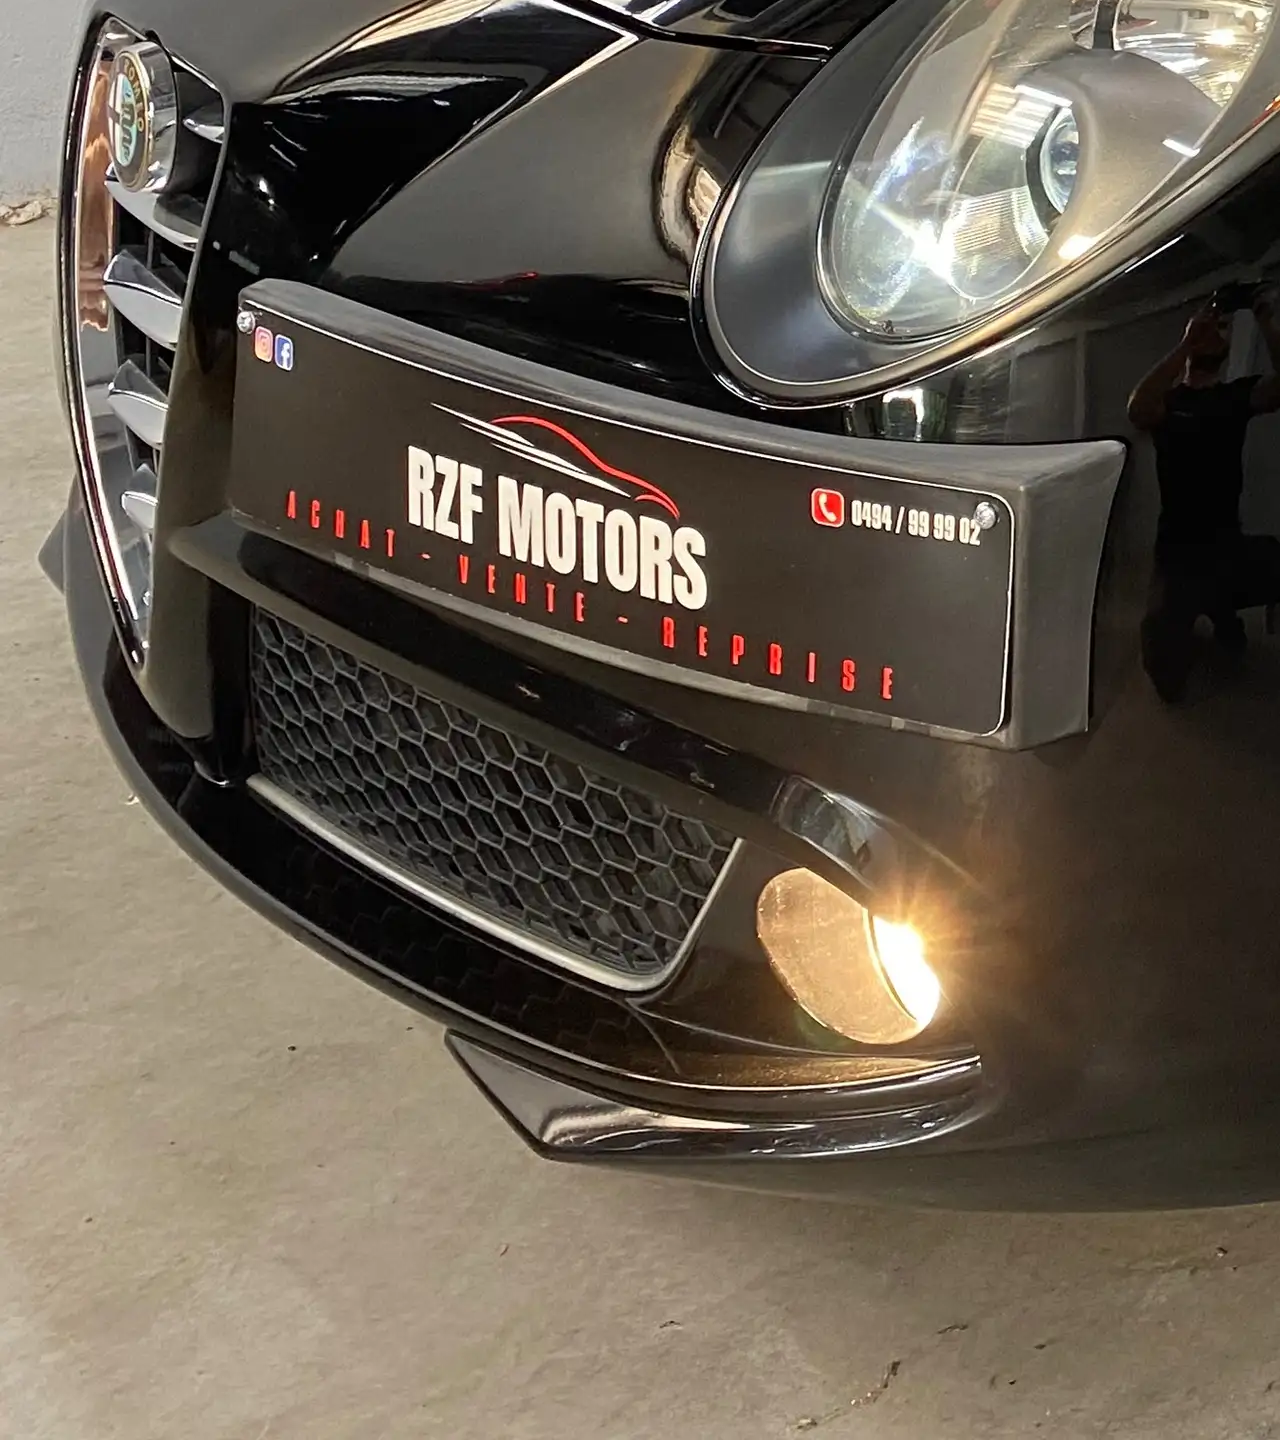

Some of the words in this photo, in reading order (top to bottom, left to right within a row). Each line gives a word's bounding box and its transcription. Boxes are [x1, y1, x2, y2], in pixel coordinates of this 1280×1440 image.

[286, 490, 396, 558] ACHAT
[456, 555, 588, 625] VENTE
[662, 615, 896, 702] REPRISE
[407, 446, 485, 547] RZF
[497, 475, 708, 610] MOTORS
[851, 500, 892, 532] 0494
[908, 509, 930, 538] 99
[933, 513, 955, 542] 99
[959, 517, 982, 546] 02
